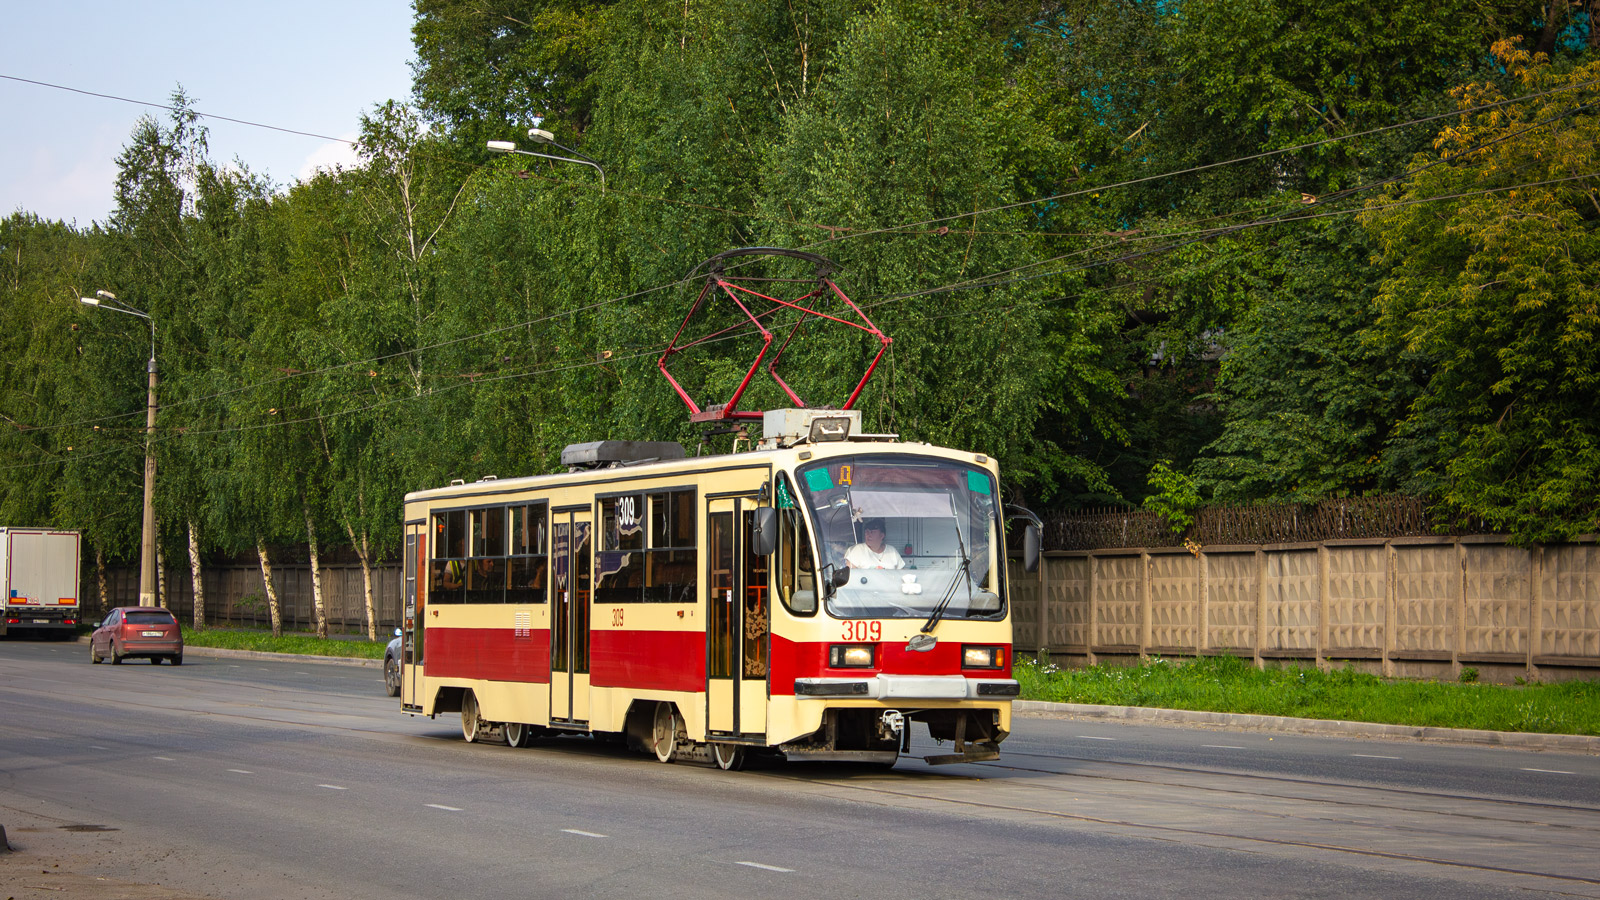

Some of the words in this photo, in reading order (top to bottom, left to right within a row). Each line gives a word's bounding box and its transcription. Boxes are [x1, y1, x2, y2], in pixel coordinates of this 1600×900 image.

[839, 466, 852, 485] Д
[619, 497, 635, 525] 309
[612, 608, 624, 627] 309
[842, 621, 881, 641] 309
